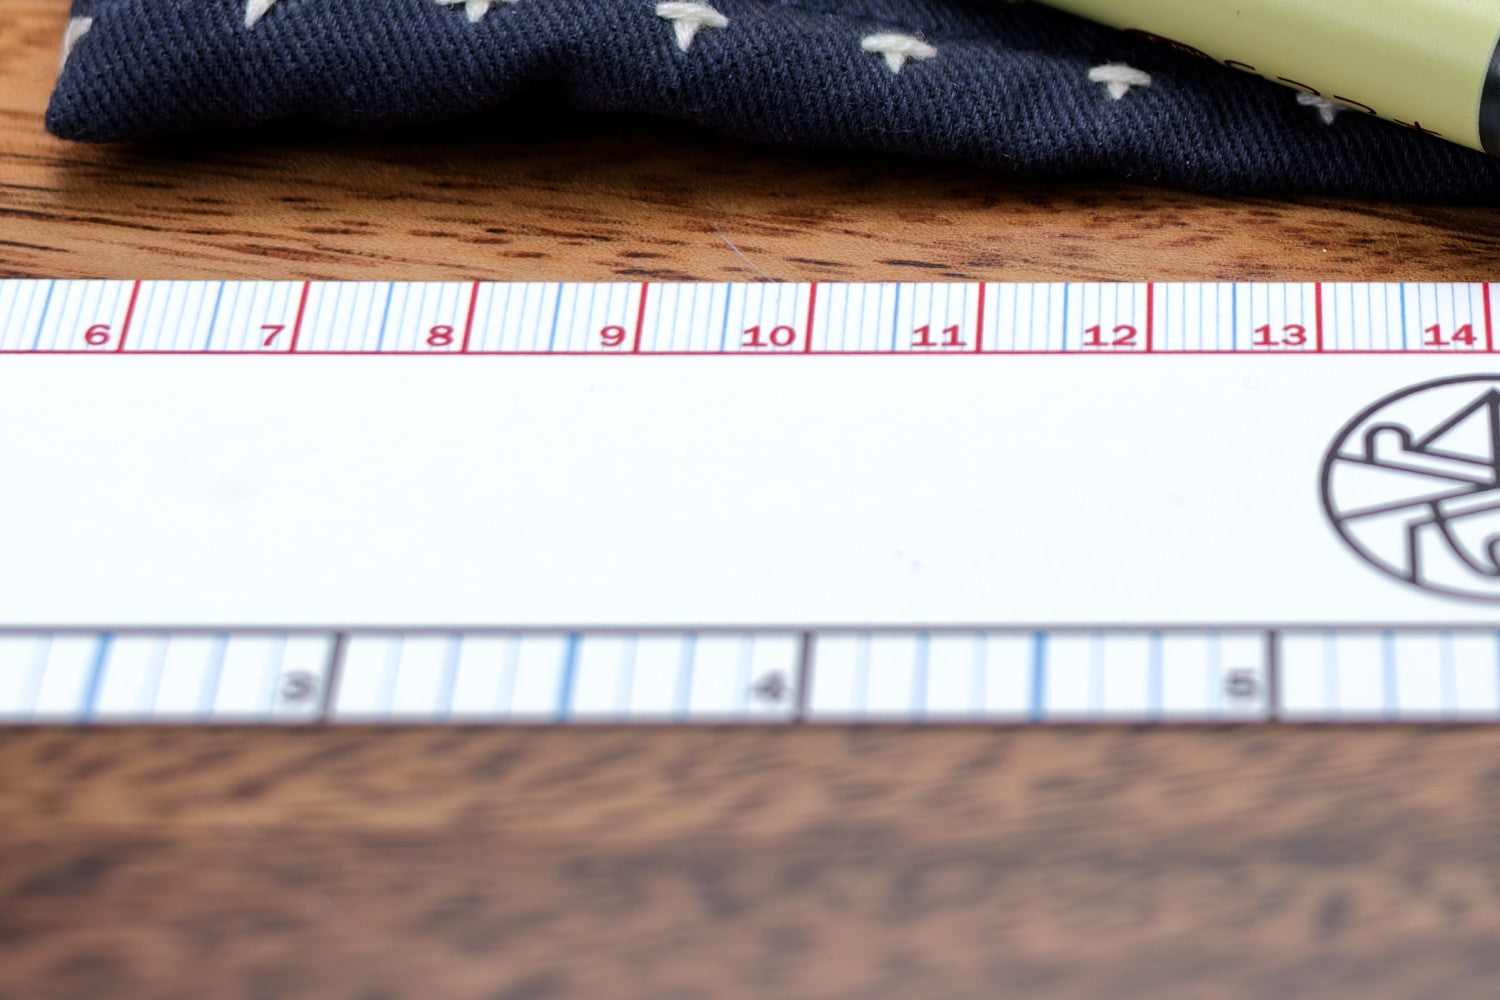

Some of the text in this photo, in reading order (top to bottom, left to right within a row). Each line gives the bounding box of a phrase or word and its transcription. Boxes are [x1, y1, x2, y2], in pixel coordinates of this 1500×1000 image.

[84, 324, 109, 346] 6
[260, 325, 285, 347] 7
[426, 325, 454, 347] 8
[600, 325, 626, 347] 9
[742, 325, 796, 347] 10
[911, 325, 966, 347] 11
[1083, 325, 1137, 346] 12
[1253, 324, 1308, 346] 13
[1423, 324, 1476, 346] 14
[281, 671, 317, 702] 3
[751, 670, 788, 702] 4
[1225, 668, 1259, 701] 5
